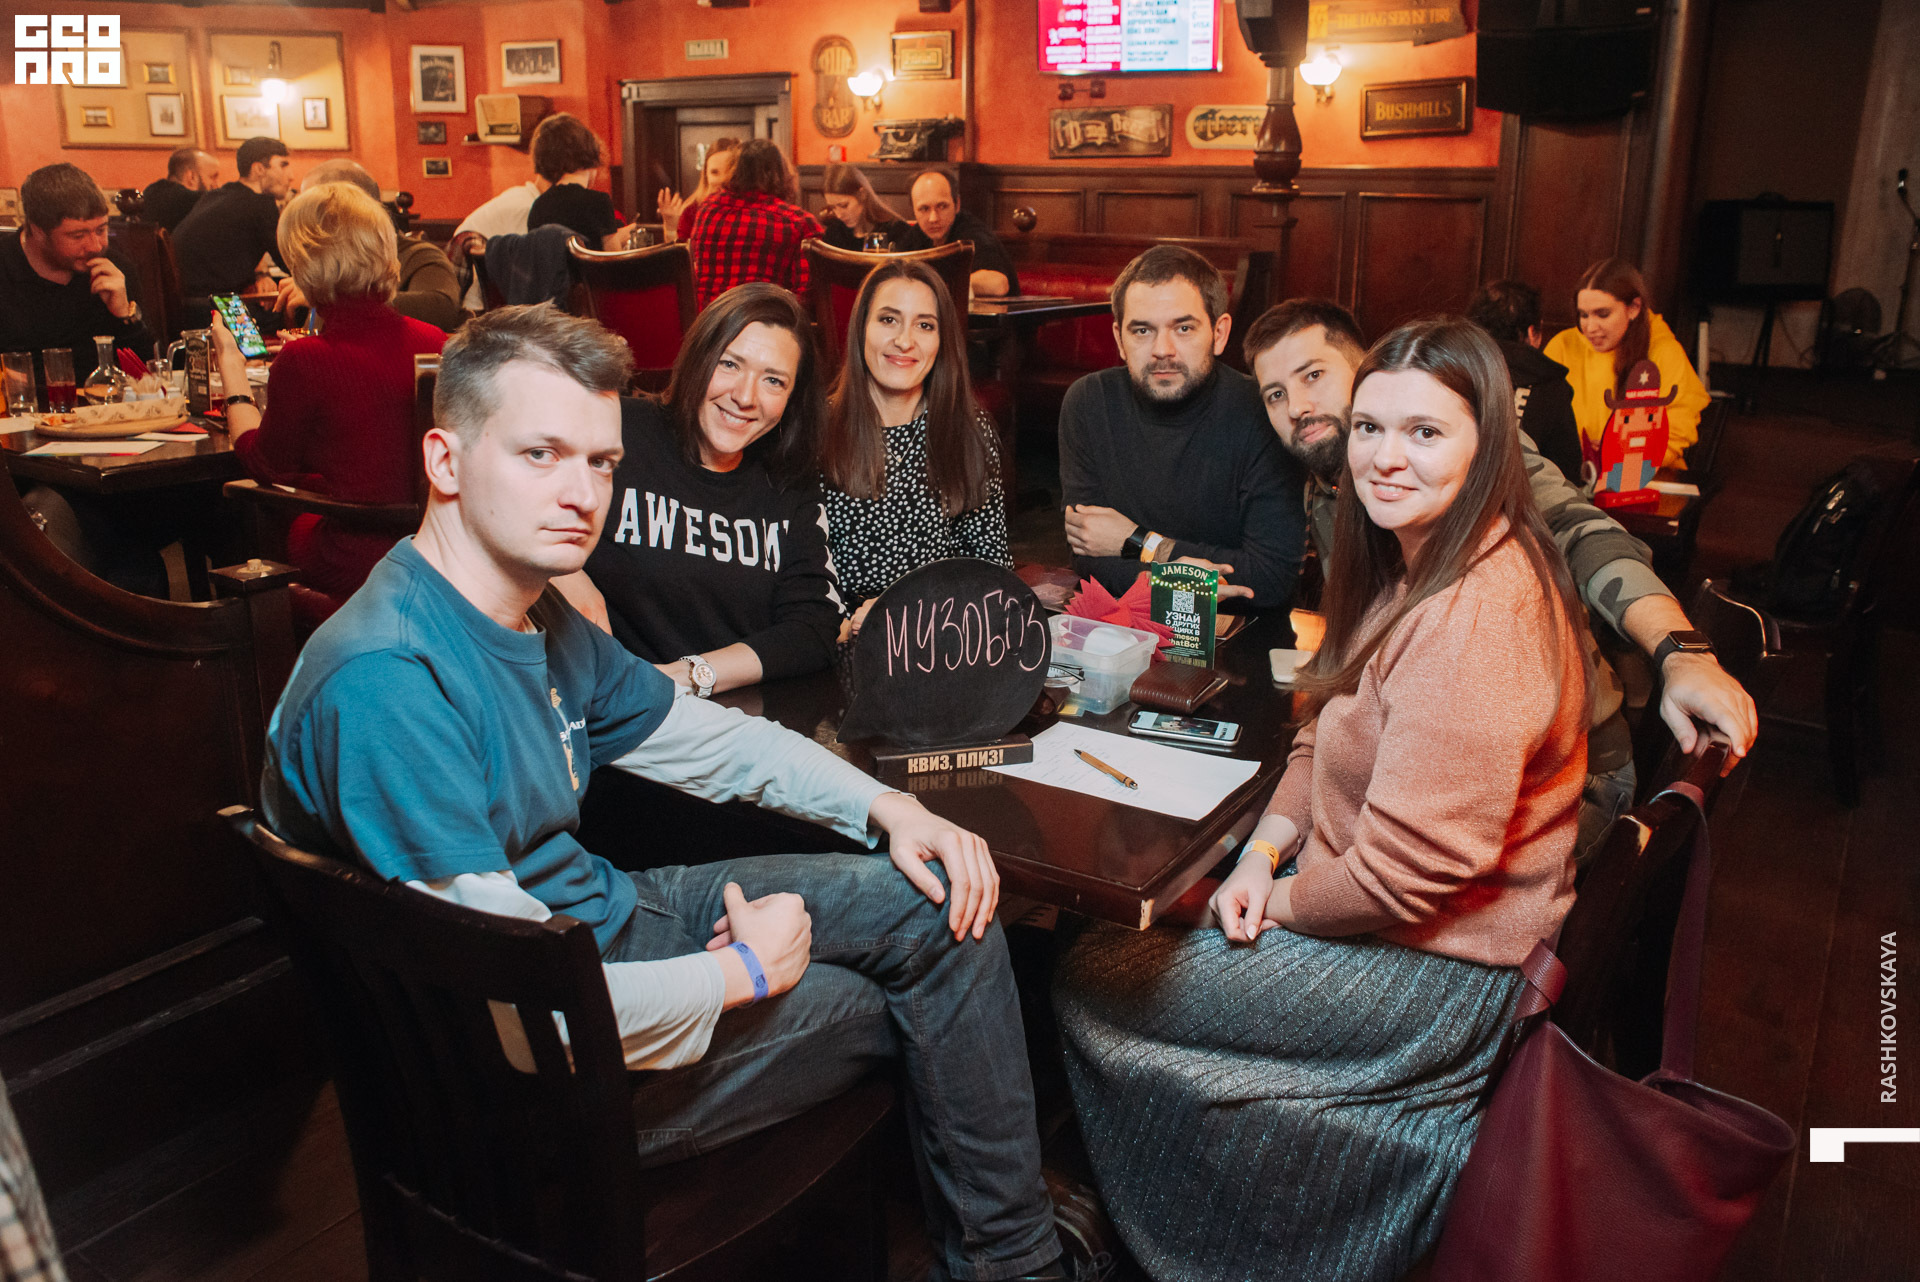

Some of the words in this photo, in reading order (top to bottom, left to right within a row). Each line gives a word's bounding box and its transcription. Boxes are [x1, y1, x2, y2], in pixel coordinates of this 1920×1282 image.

[1375, 100, 1451, 121] BUSHMILLS
[1161, 565, 1208, 580] JAMESON
[1165, 611, 1200, 624] УЗНАЙ
[1167, 625, 1193, 635] ЦИЯХ
[1172, 620, 1200, 629] ДРУГИХ
[1169, 638, 1199, 649] hatBot
[1173, 633, 1199, 642] meson
[908, 754, 953, 773] КВИЗ,
[956, 749, 1004, 768] ПЛИЗ!
